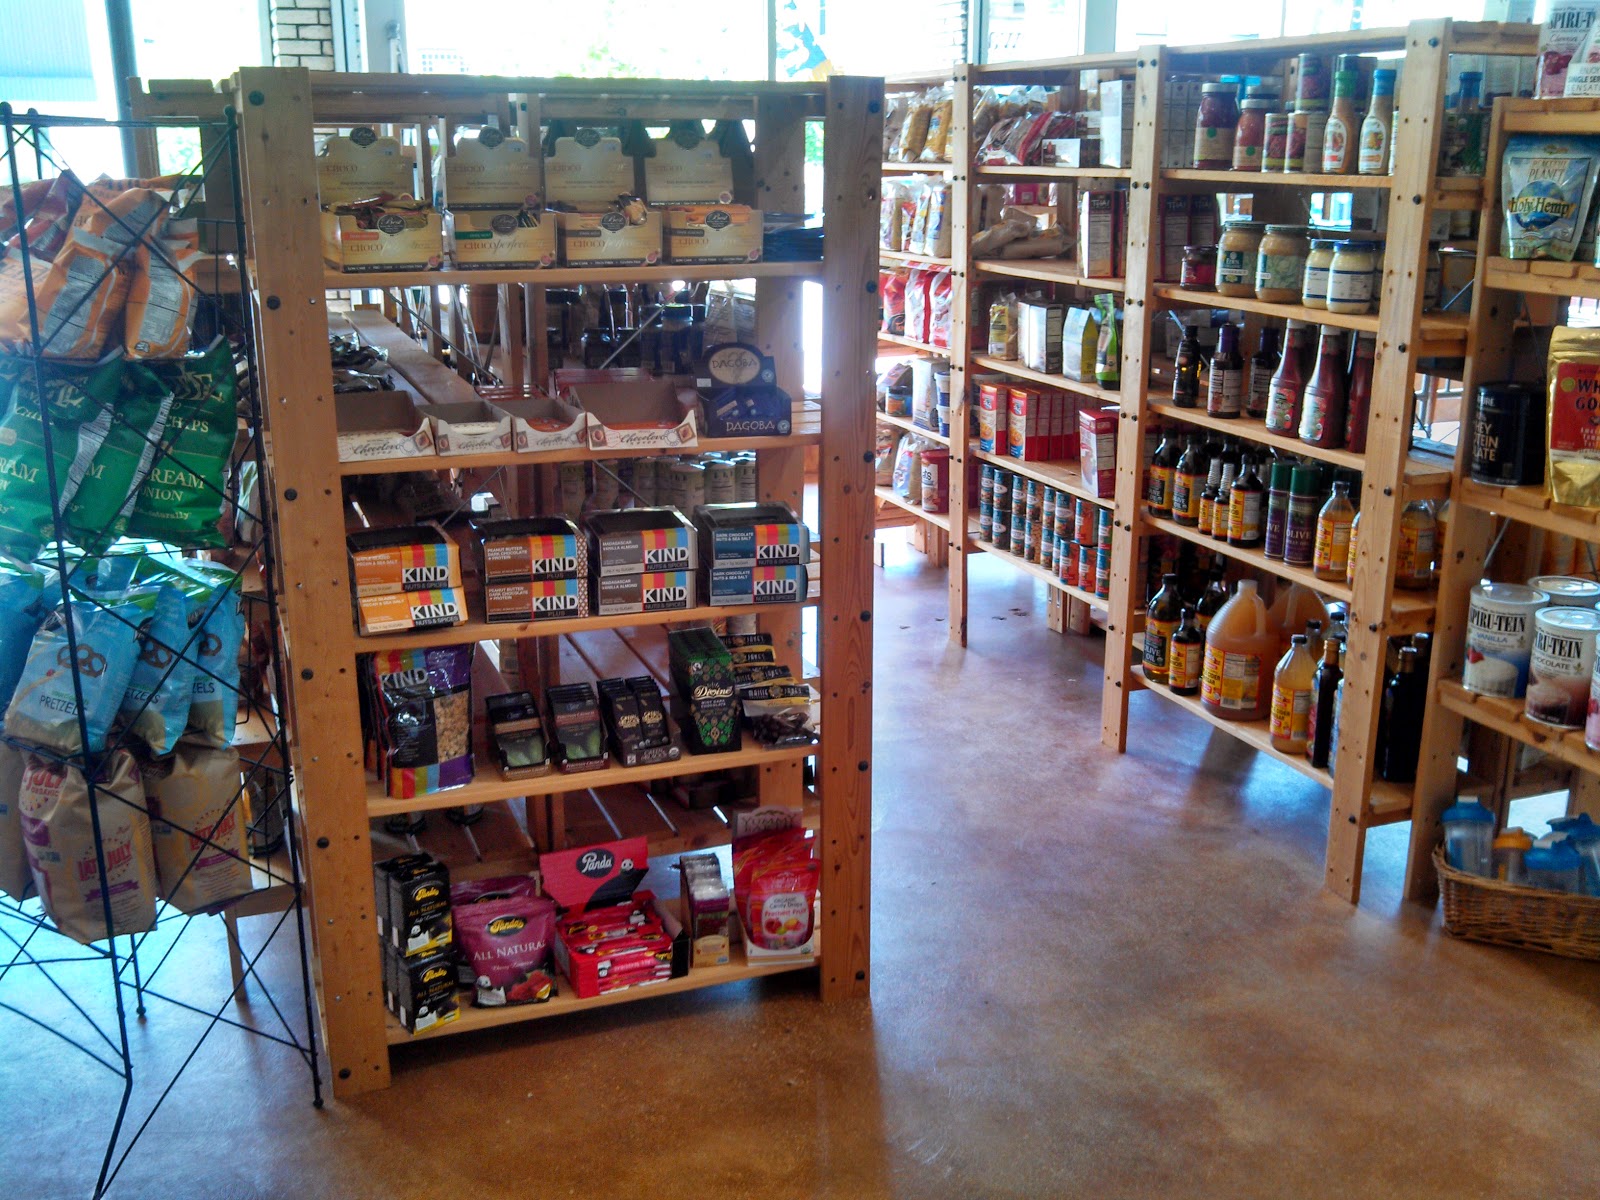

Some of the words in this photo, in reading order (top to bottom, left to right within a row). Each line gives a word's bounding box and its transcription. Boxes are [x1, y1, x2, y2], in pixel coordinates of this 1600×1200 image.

[1535, 197, 1570, 217] Hemp
[712, 360, 758, 368] DAGOBA
[164, 416, 209, 433] CHPS
[725, 420, 776, 431] DAGOBA
[1474, 421, 1492, 435] HEY
[1473, 446, 1496, 462] LATE
[150, 467, 205, 489] REAM
[644, 547, 689, 564] KIND
[756, 544, 800, 559] KIND
[532, 557, 578, 574] KIND
[402, 565, 449, 584] KIND
[643, 586, 687, 603] KIND
[754, 579, 797, 595] KIND
[410, 602, 459, 620] KIND
[532, 595, 579, 612] KIND
[415, 618, 432, 626] NUTS
[1470, 608, 1527, 632] PIRU-TEIN
[1476, 632, 1508, 643] VANILLA
[1533, 656, 1571, 670] OCOLATE
[379, 668, 429, 691] KIND
[125, 687, 161, 705] ETZES
[694, 684, 733, 698] Divine
[581, 852, 612, 873] Panda
[490, 918, 524, 934] Panda
[473, 951, 494, 961] ALL
[423, 968, 448, 983] Panda
